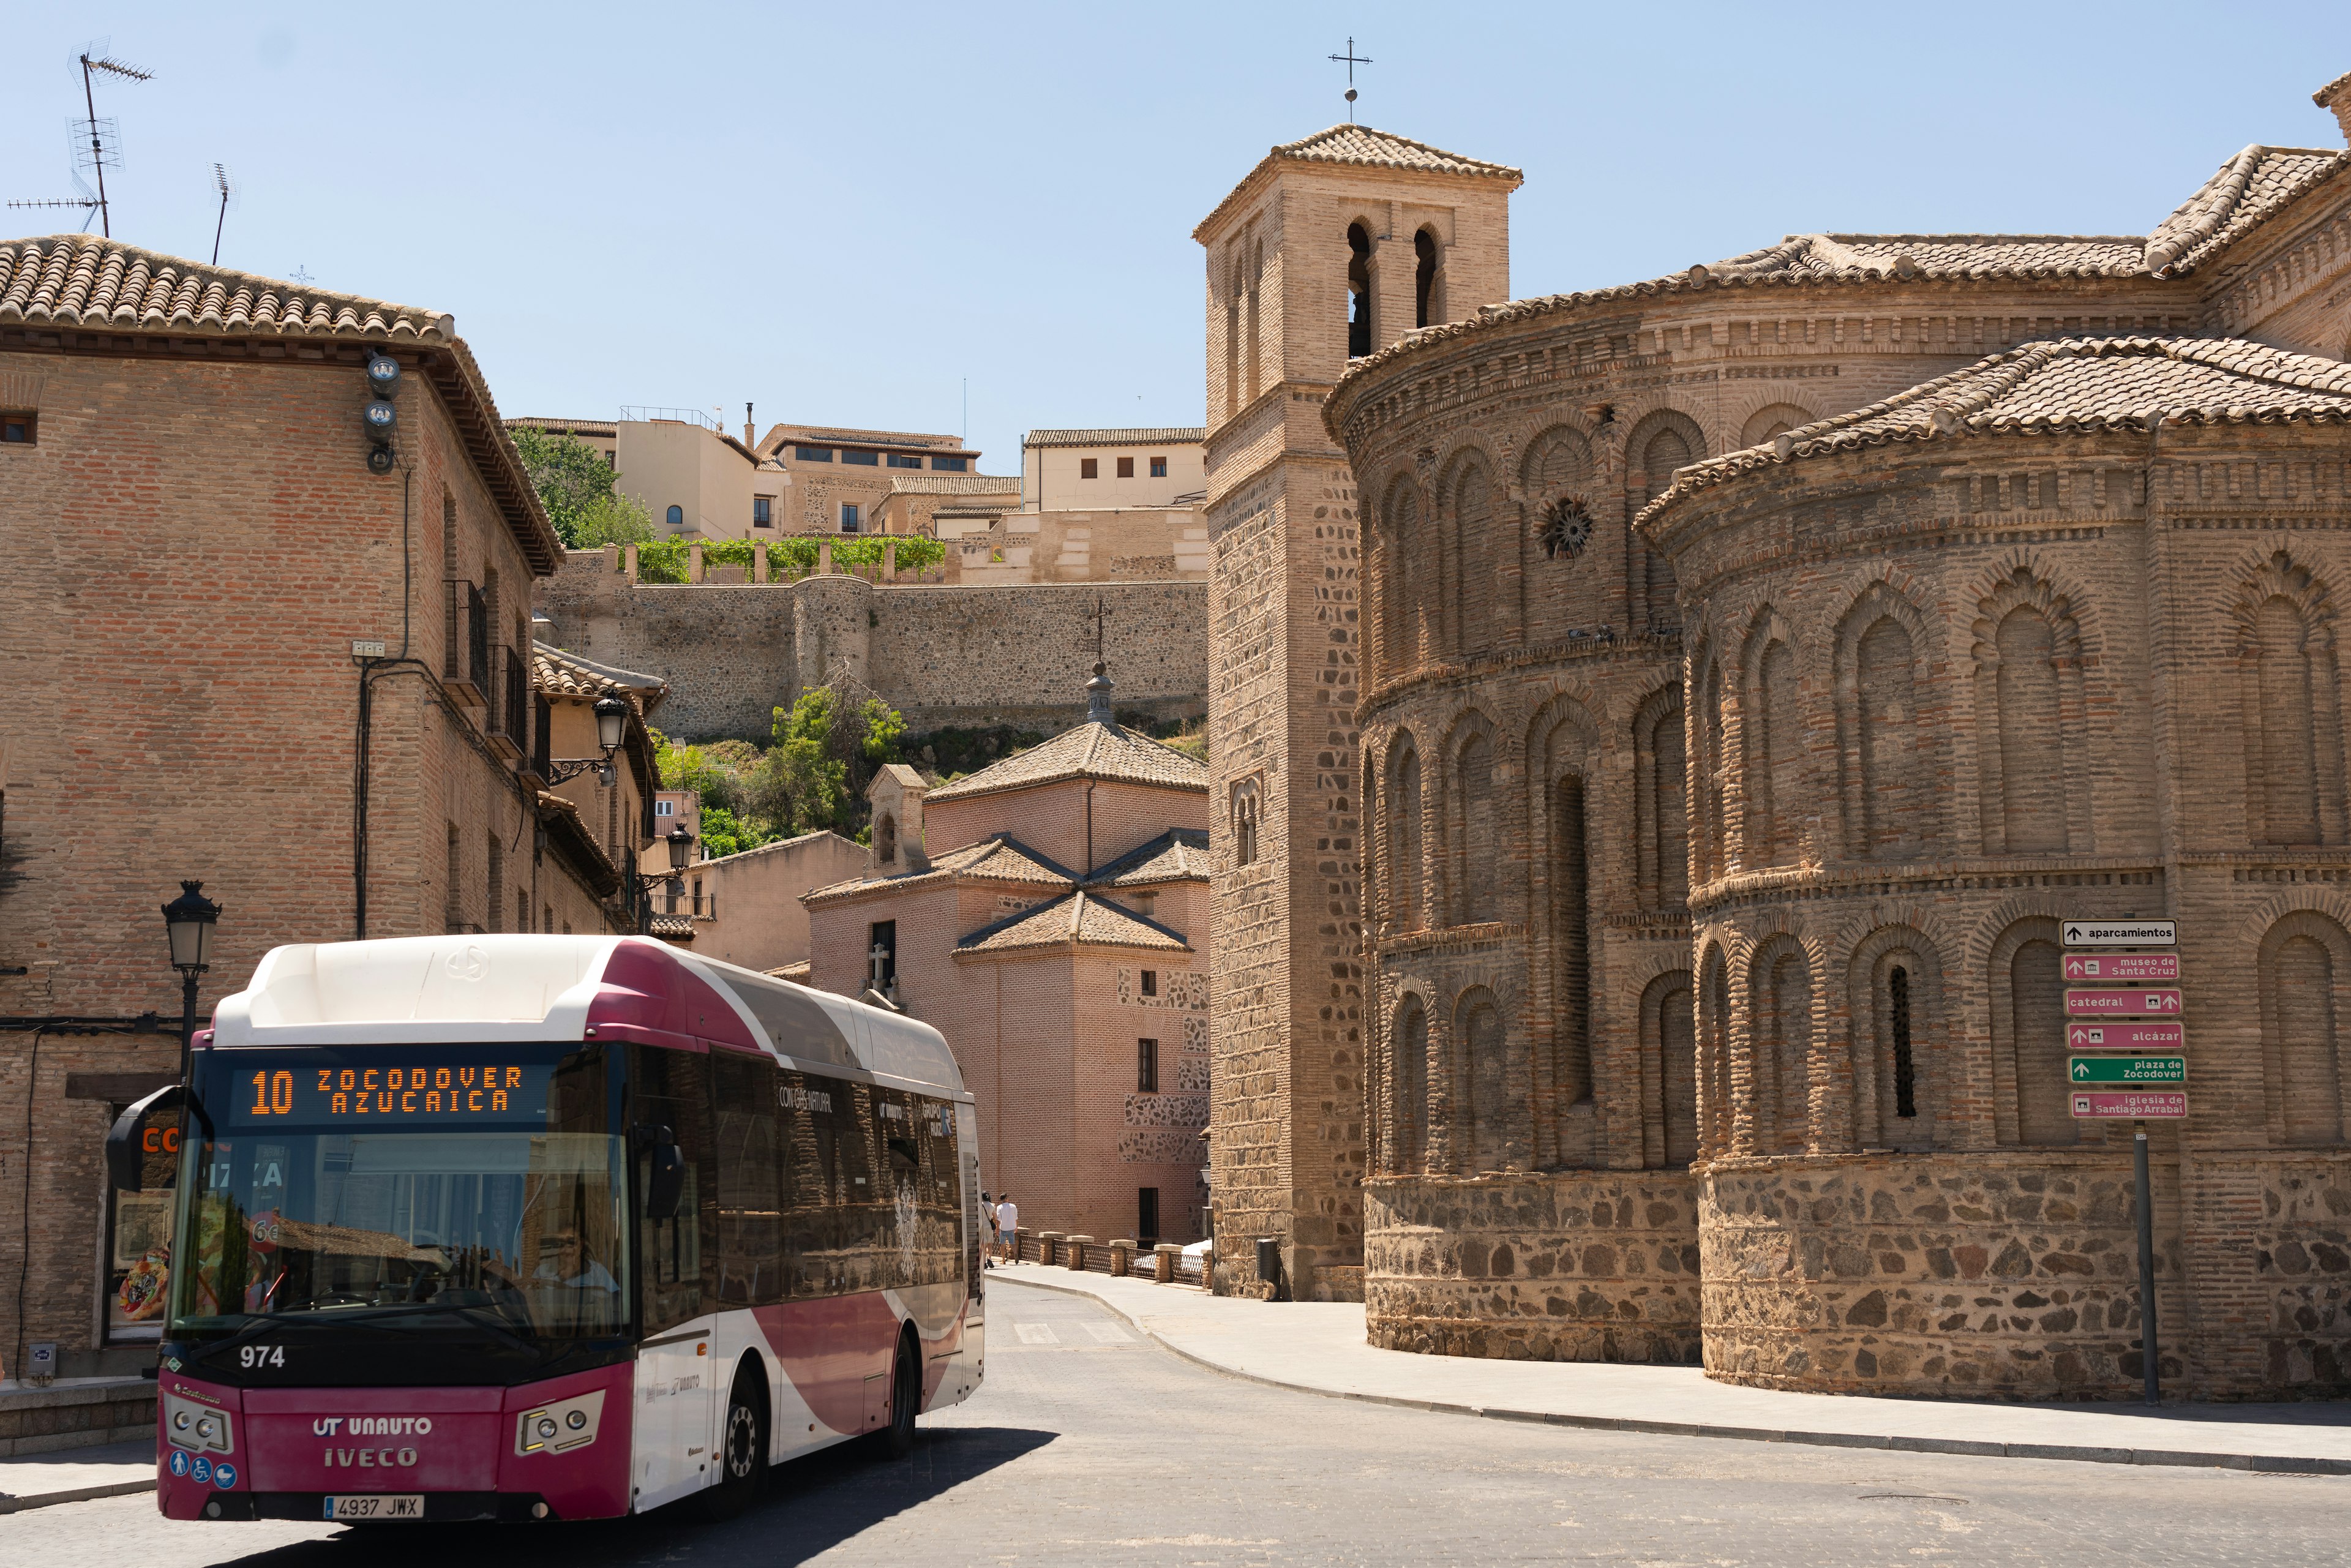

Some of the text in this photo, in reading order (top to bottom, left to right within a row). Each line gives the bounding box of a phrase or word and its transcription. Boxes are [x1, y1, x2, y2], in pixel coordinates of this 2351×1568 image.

[2089, 928, 2172, 939] aparcamientos
[2112, 967, 2175, 975] Santa Cruz
[2070, 997, 2123, 1007] catedral
[2132, 1032, 2179, 1041] alcázar
[2135, 1060, 2181, 1070] plaza de
[318, 1067, 522, 1091] ZOCODOVER
[2123, 1070, 2181, 1078] Zocodover
[252, 1070, 293, 1114] 10
[779, 1086, 832, 1113] CON GAS NATURAL
[332, 1089, 508, 1113] AZUCAICA
[2124, 1095, 2165, 1106] iglesia
[922, 1103, 941, 1119] GRUPO
[2096, 1105, 2183, 1116] Santiago Arrabal
[931, 1122, 942, 1136] RUIZ
[241, 1345, 285, 1368] 974
[349, 1417, 432, 1435] UNAUTO
[324, 1447, 418, 1467] IVECO
[339, 1499, 380, 1516] 4937
[387, 1498, 418, 1515] JWX
